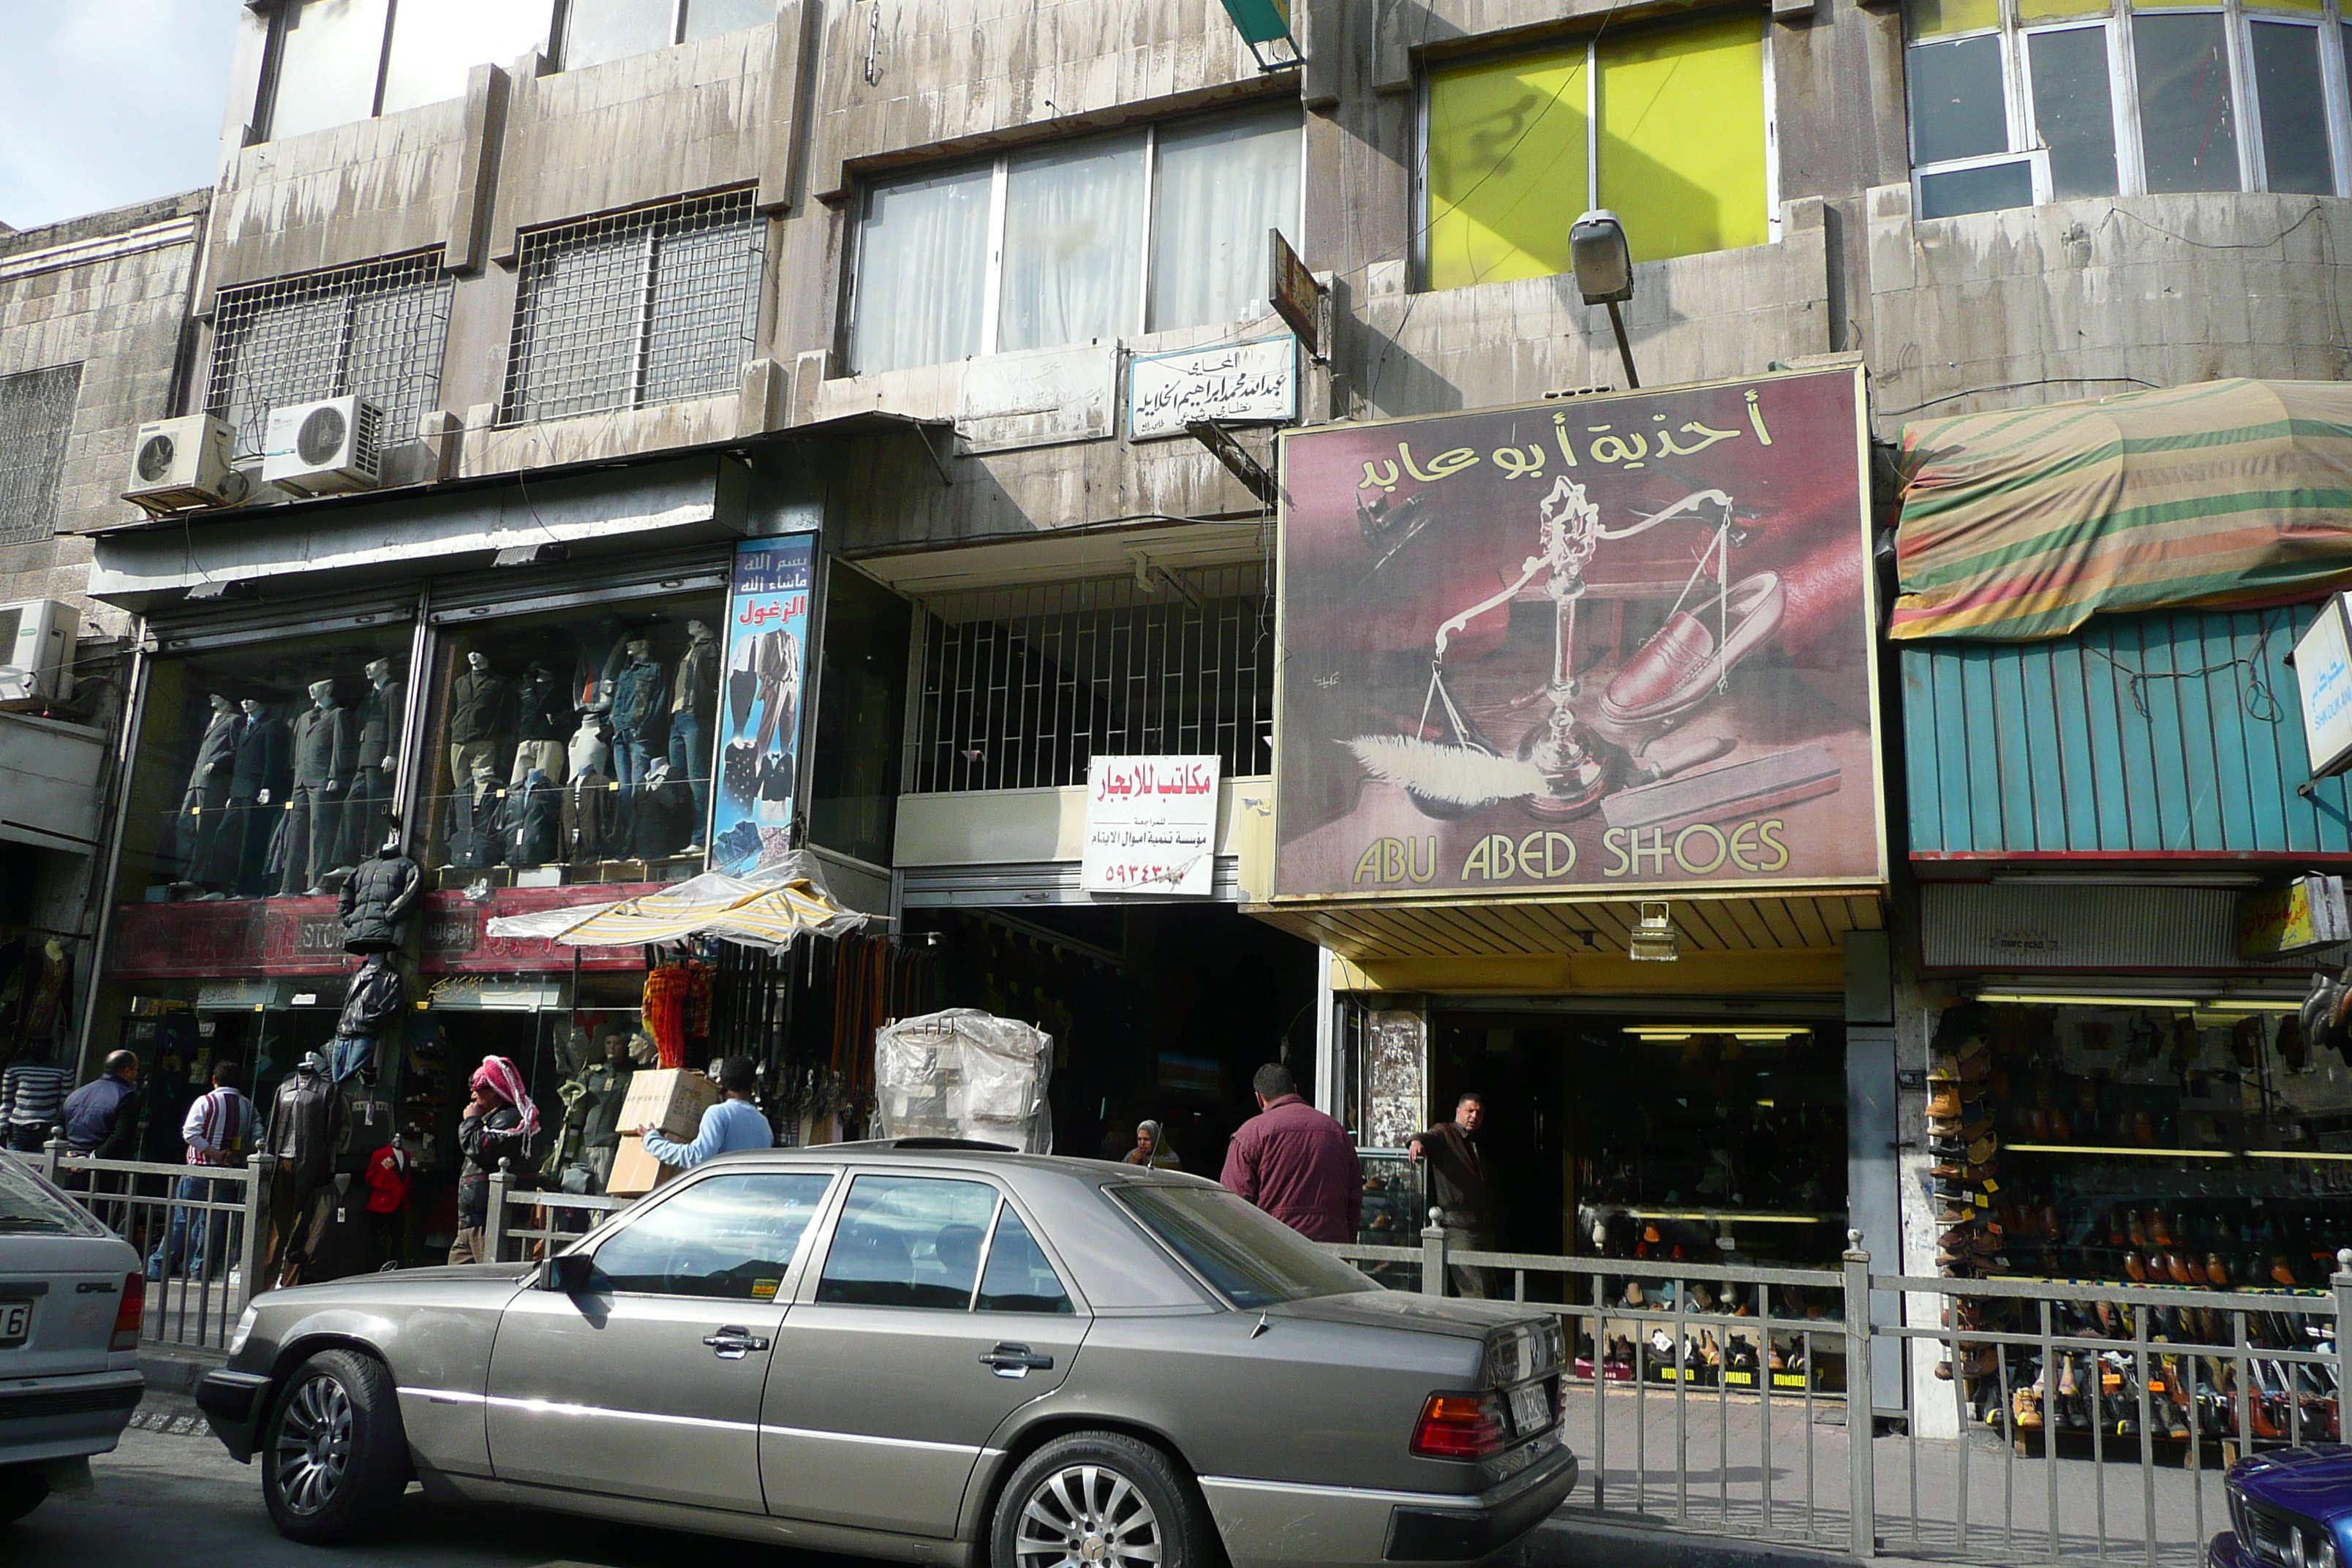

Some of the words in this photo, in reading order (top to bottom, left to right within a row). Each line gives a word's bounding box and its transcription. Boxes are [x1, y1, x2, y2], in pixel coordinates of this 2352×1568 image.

[1188, 352, 1237, 375] المحامي
[1589, 388, 1772, 470] أحذية
[1492, 412, 1578, 480] أبو
[1357, 442, 1480, 491] عابد
[745, 552, 771, 571] الله
[775, 557, 807, 572] بسم
[741, 573, 764, 592] الله
[739, 595, 806, 625] الزغول
[1097, 761, 1154, 803] للايجار
[1157, 762, 1210, 803] مكاتب
[1134, 818, 1166, 827] للمراجعة
[1147, 830, 1174, 847] تنمية
[1175, 831, 1207, 848] مؤسسة
[1354, 836, 1436, 883] ABU
[1461, 831, 1577, 881] ABED
[1603, 820, 1790, 878] SHOES
[2001, 940, 2022, 948] marc
[76, 1283, 118, 1293] OPEL
[1662, 1367, 1695, 1381] HUMER
[1718, 1371, 1752, 1384] UMMER
